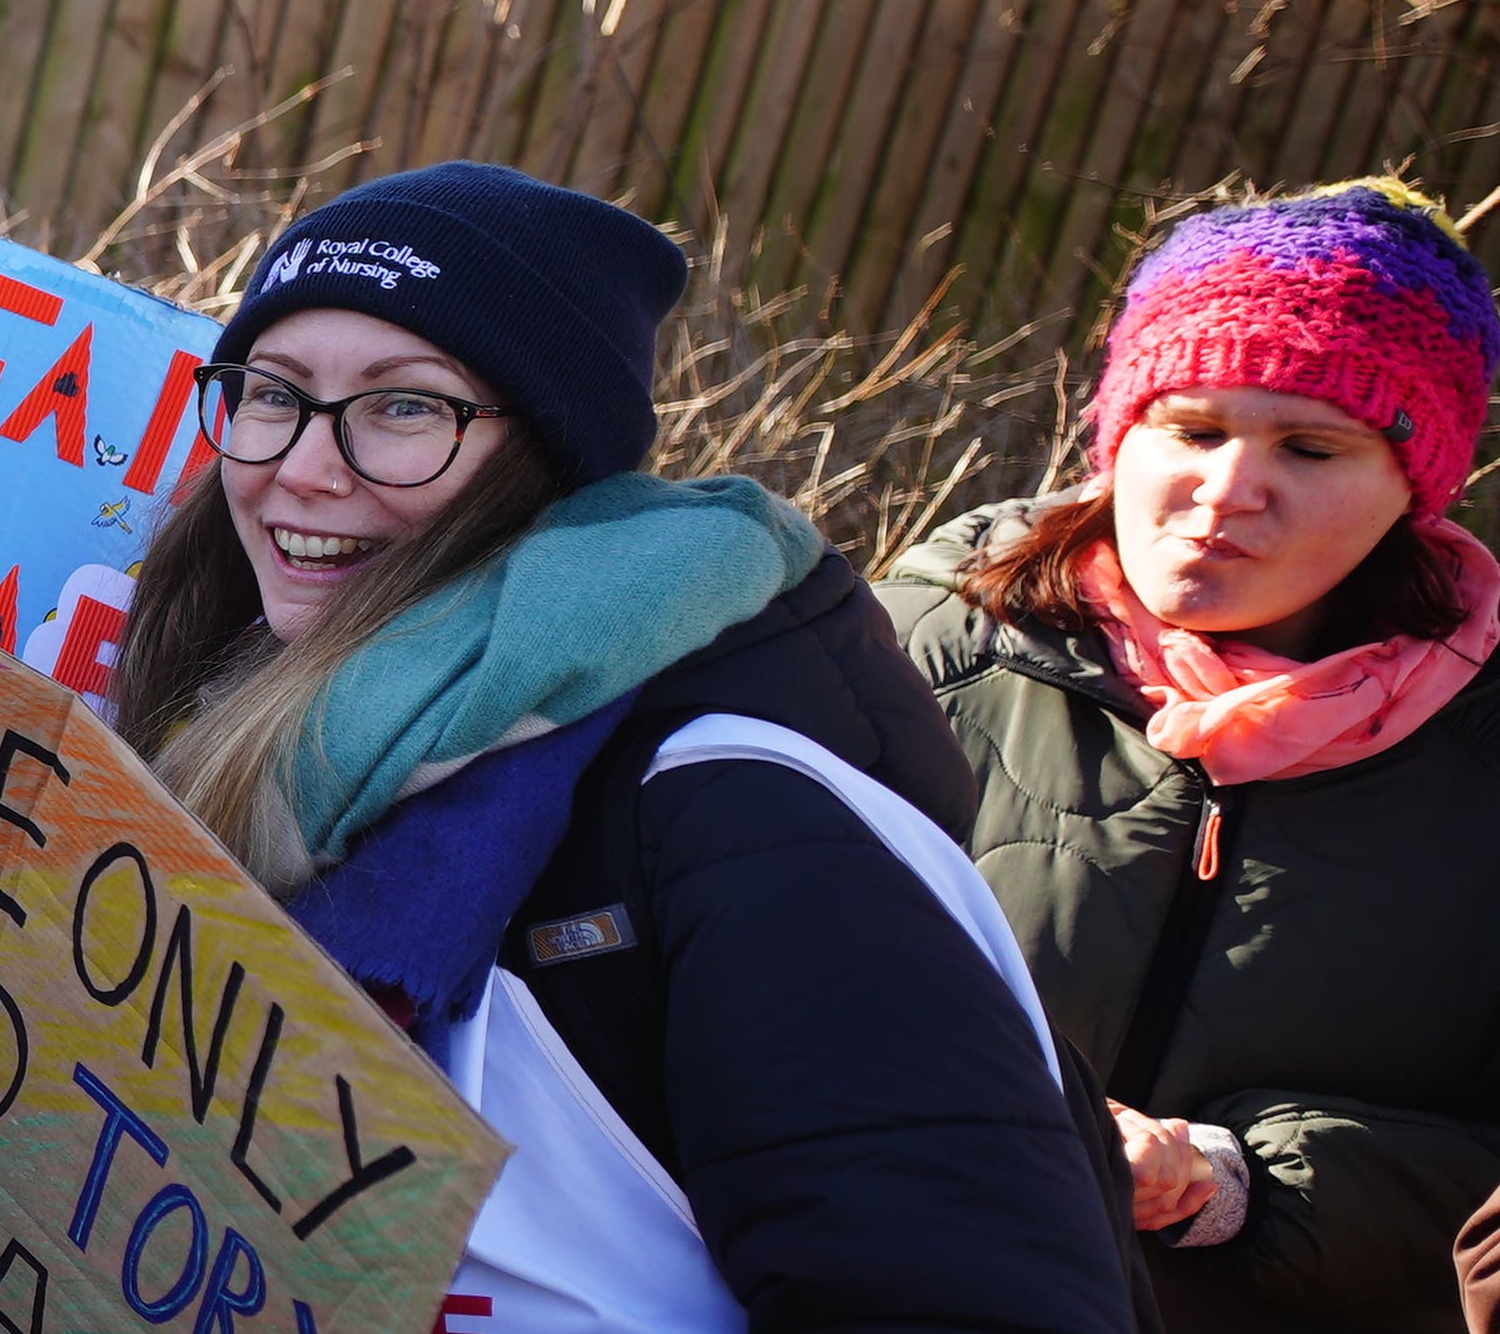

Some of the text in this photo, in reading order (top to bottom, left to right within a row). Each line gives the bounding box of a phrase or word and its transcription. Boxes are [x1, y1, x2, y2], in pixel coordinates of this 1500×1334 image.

[307, 257, 403, 290] of Nursing
[316, 237, 442, 280] Royal College
[72, 840, 417, 1242] ONLY
